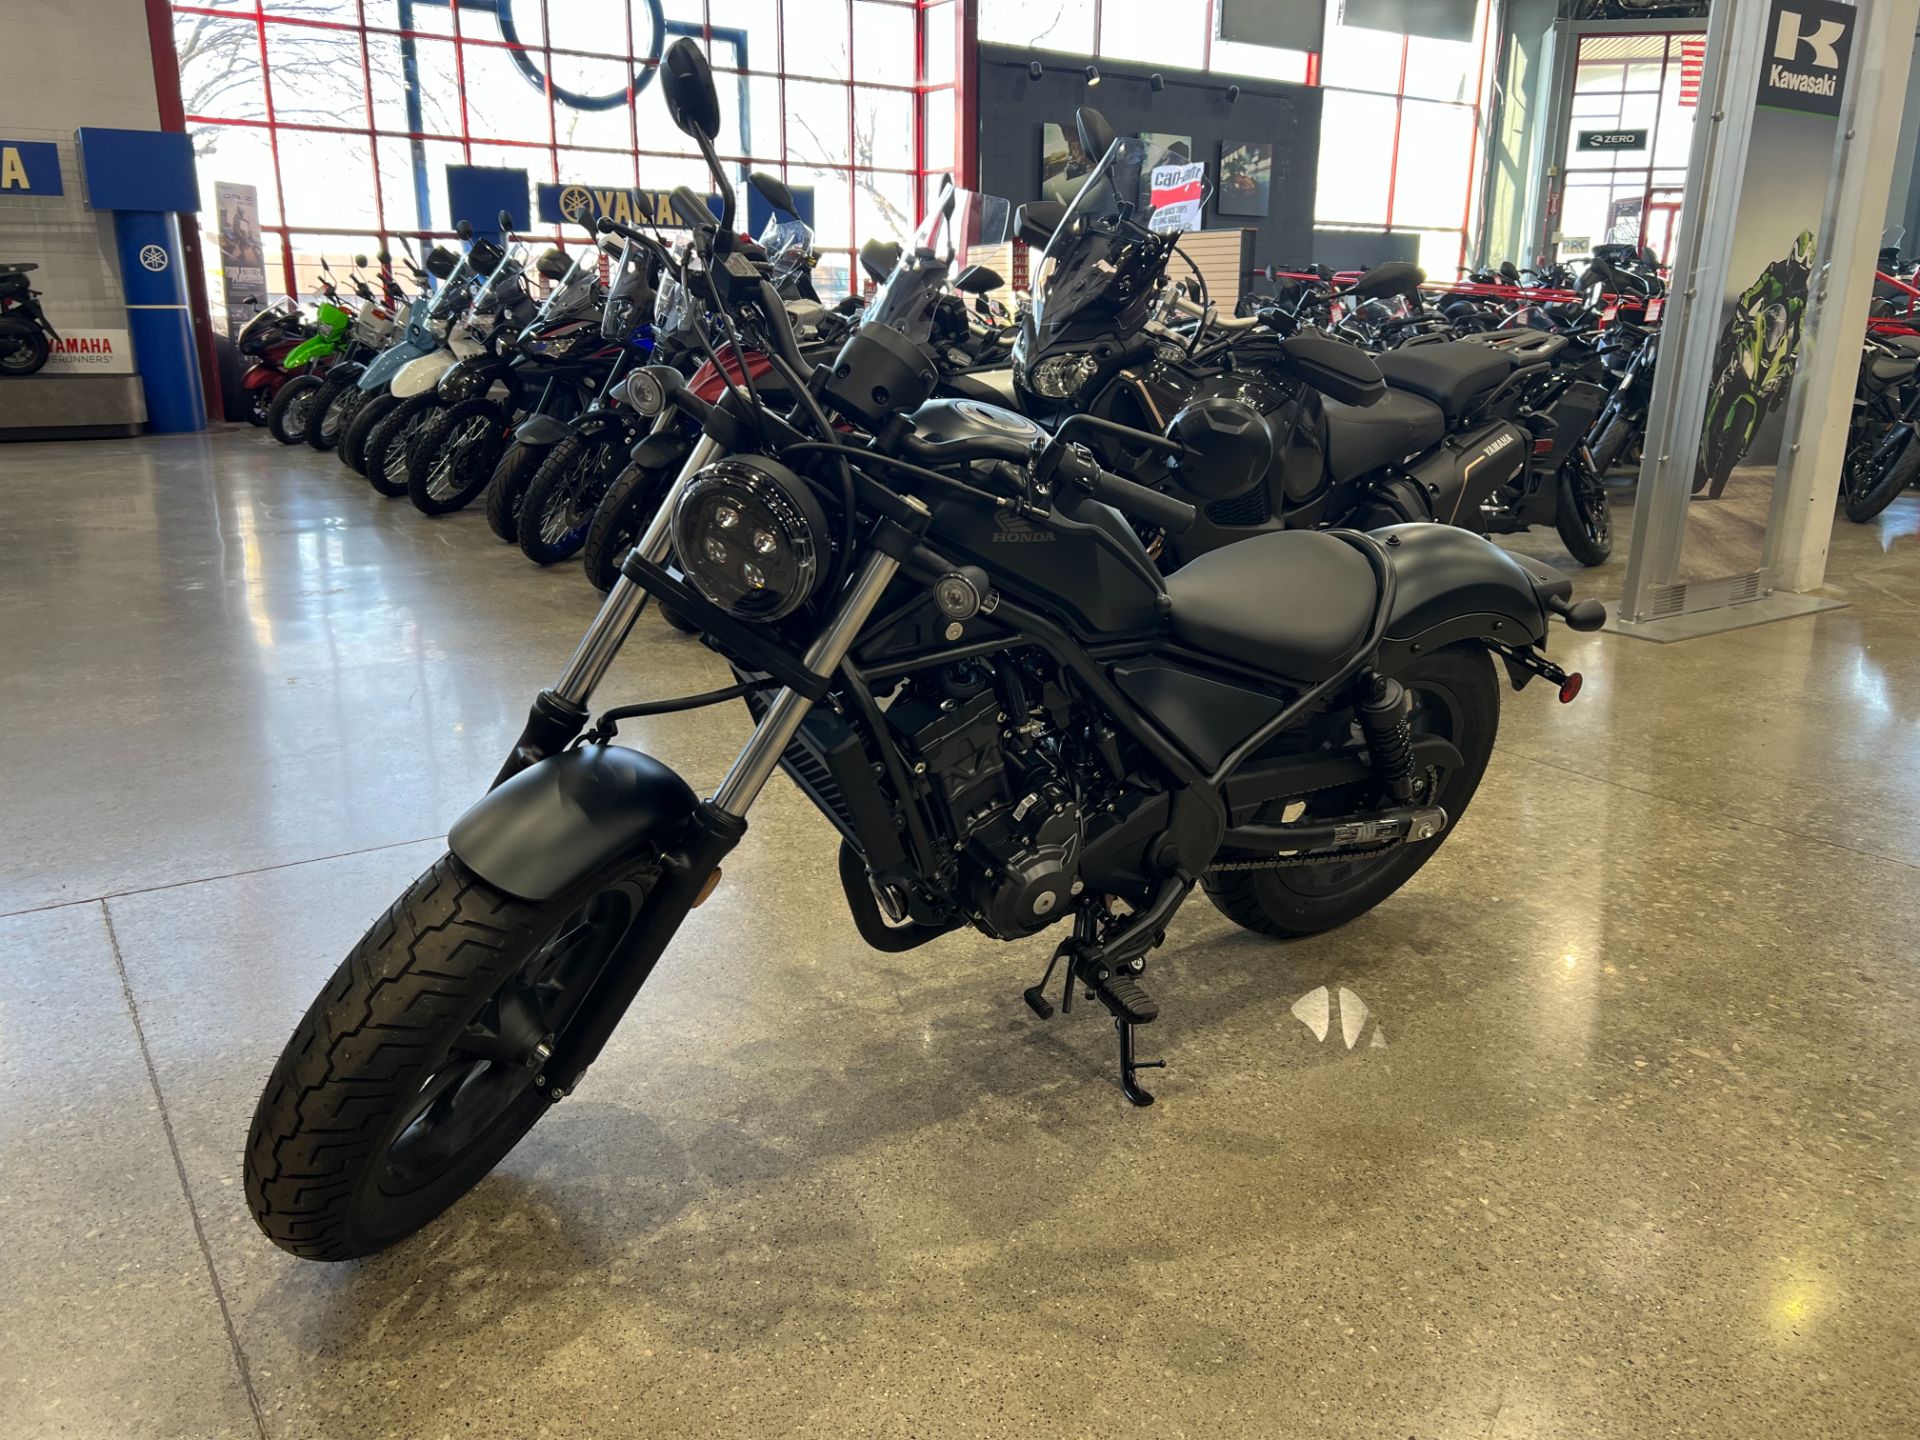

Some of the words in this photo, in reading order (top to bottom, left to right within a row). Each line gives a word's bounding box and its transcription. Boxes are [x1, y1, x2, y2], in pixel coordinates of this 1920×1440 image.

[1769, 64, 1837, 96] Kawasaki
[1603, 134, 1636, 143] ZERO
[1013, 267, 1029, 275] SALE
[1013, 278, 1029, 287] SALE
[1483, 433, 1514, 457] YAMAHA
[992, 532, 1057, 543] HONDA
